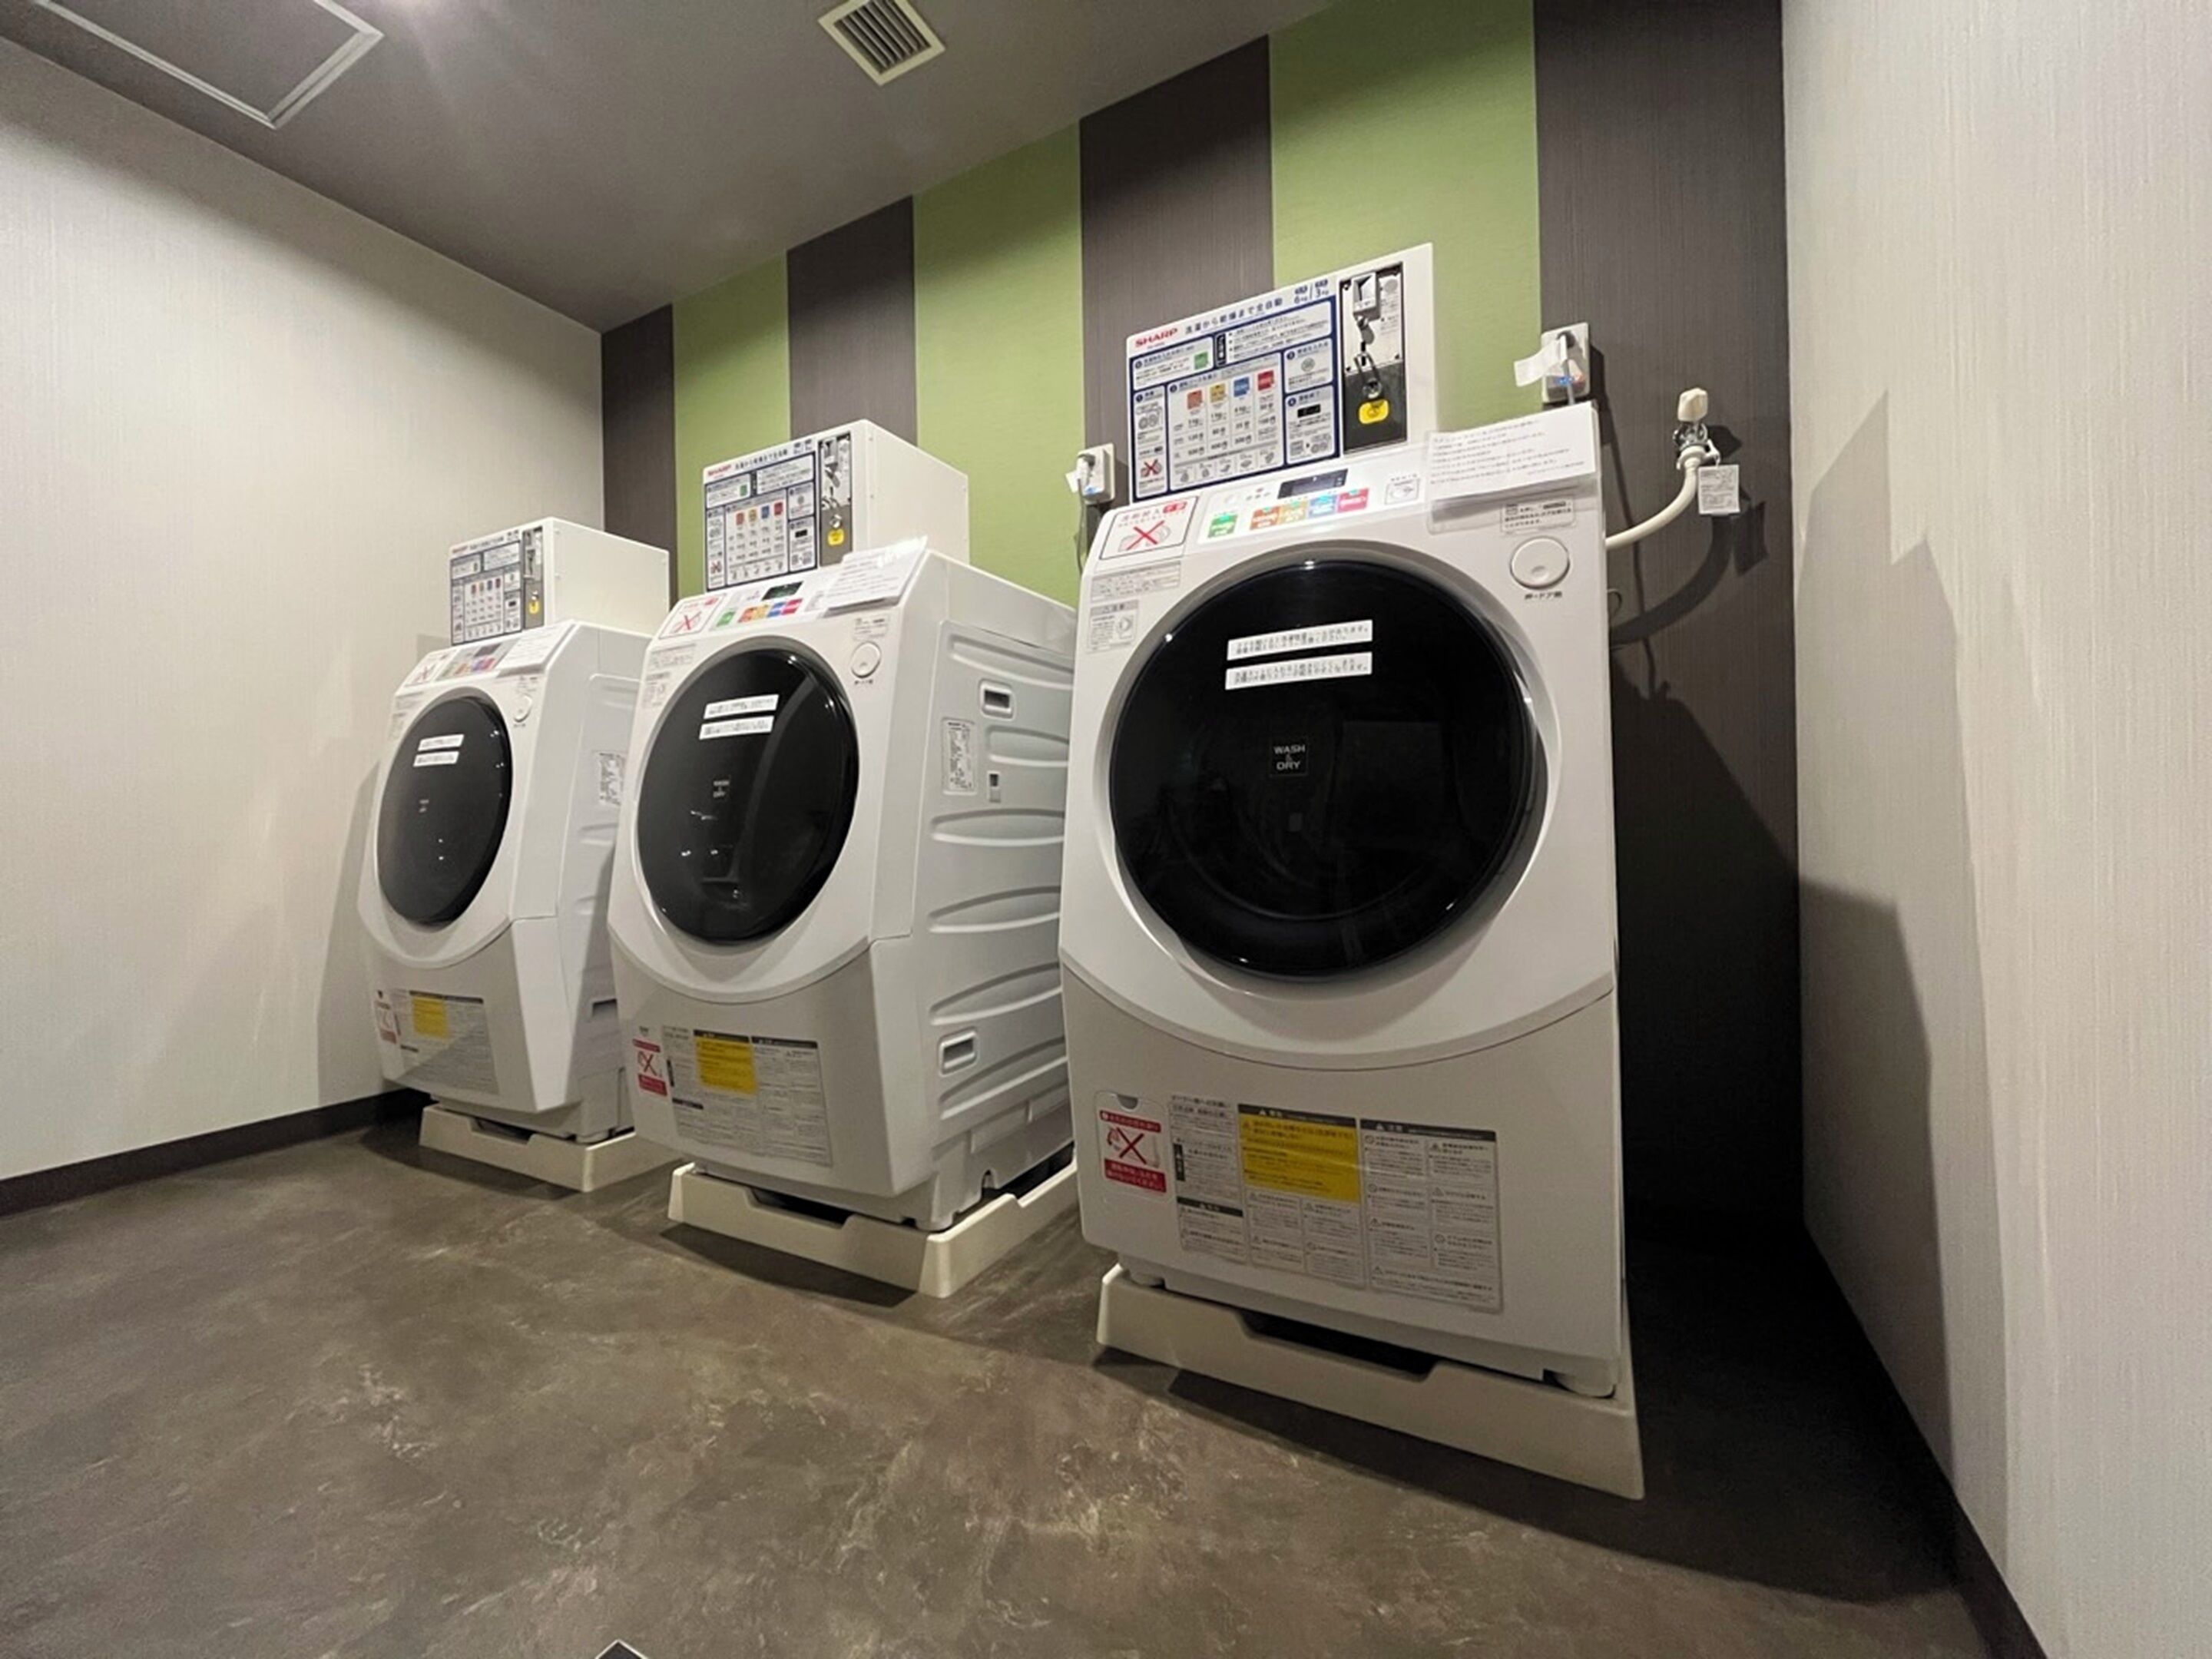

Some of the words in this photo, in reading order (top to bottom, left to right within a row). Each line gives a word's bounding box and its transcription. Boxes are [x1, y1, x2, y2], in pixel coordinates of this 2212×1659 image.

[1135, 327, 1178, 348] SHARP
[1273, 744, 1306, 754] WASH
[1277, 760, 1300, 771] DRY
